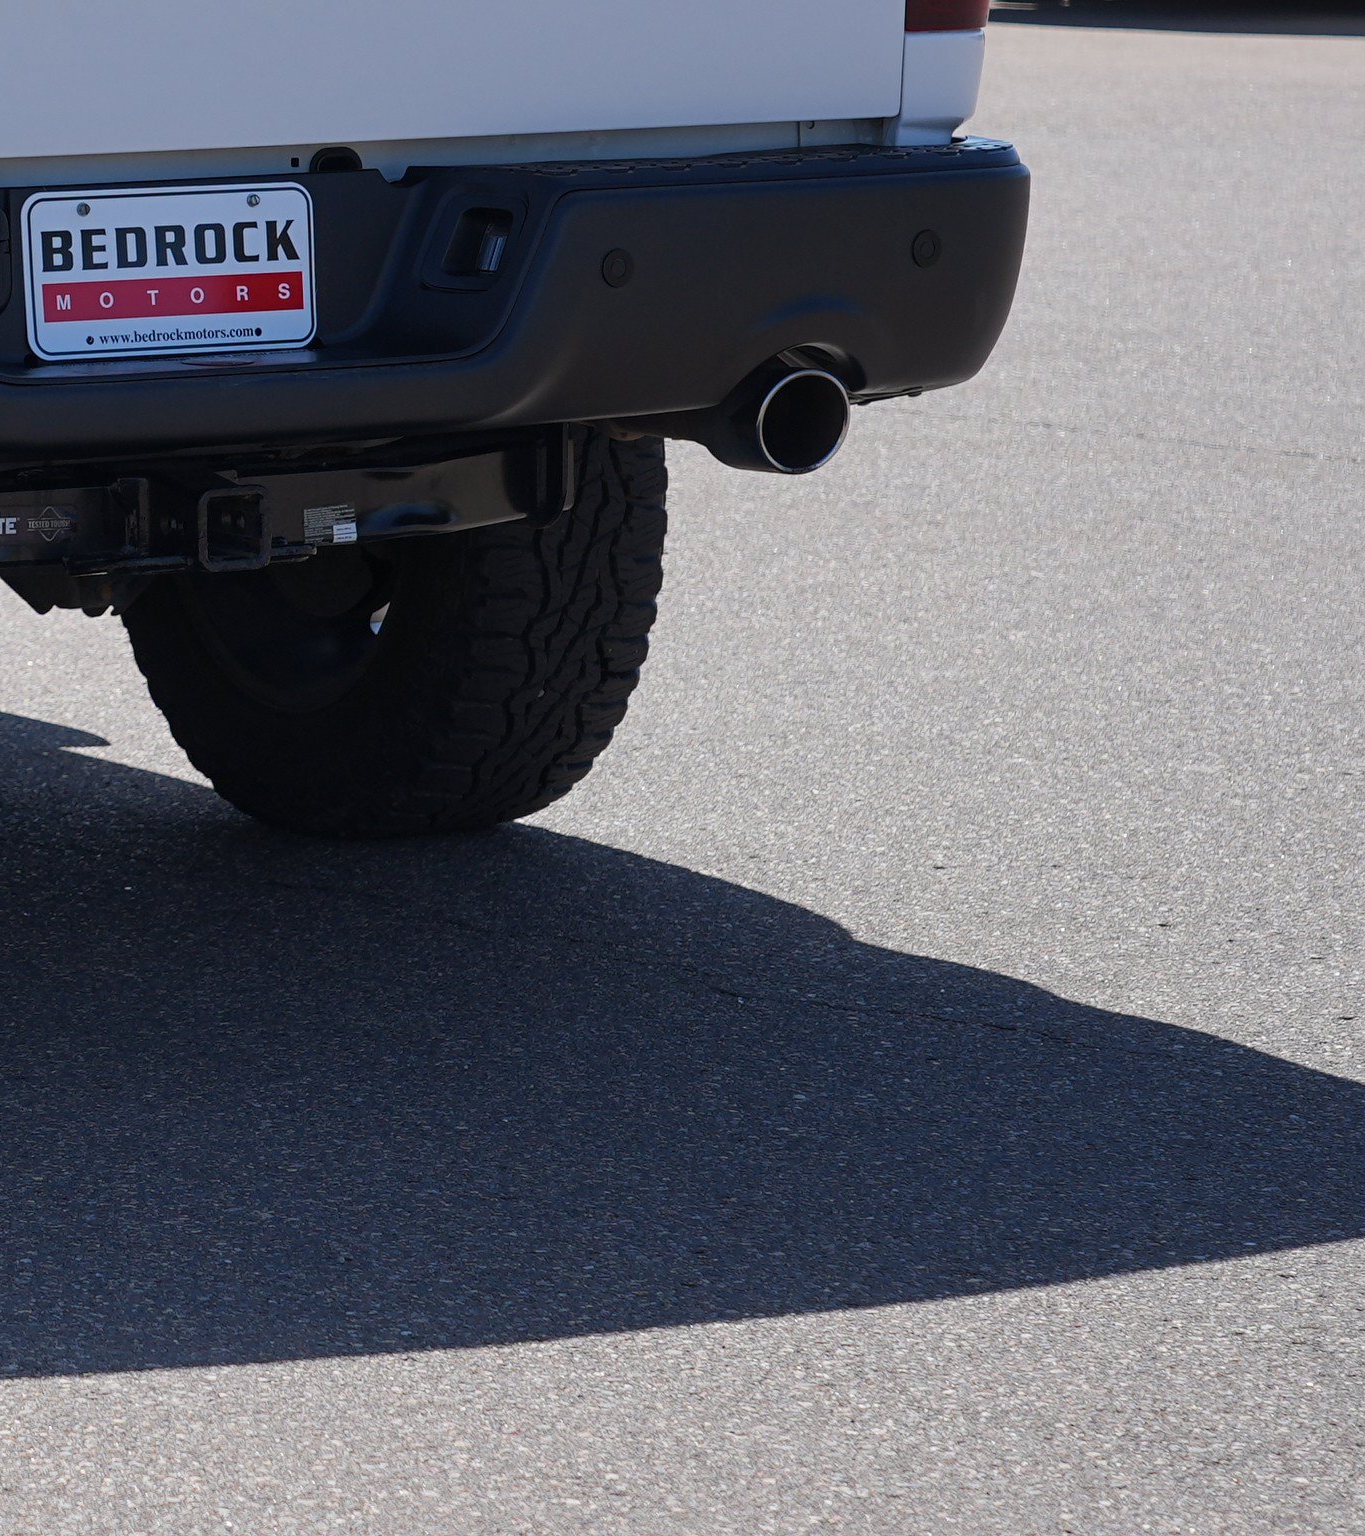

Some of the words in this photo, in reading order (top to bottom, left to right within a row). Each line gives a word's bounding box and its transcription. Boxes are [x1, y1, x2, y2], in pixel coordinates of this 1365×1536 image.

[40, 219, 300, 273] BEDROCK
[55, 282, 292, 311] MOTORS
[99, 325, 254, 346] www.bedrockmotors.com
